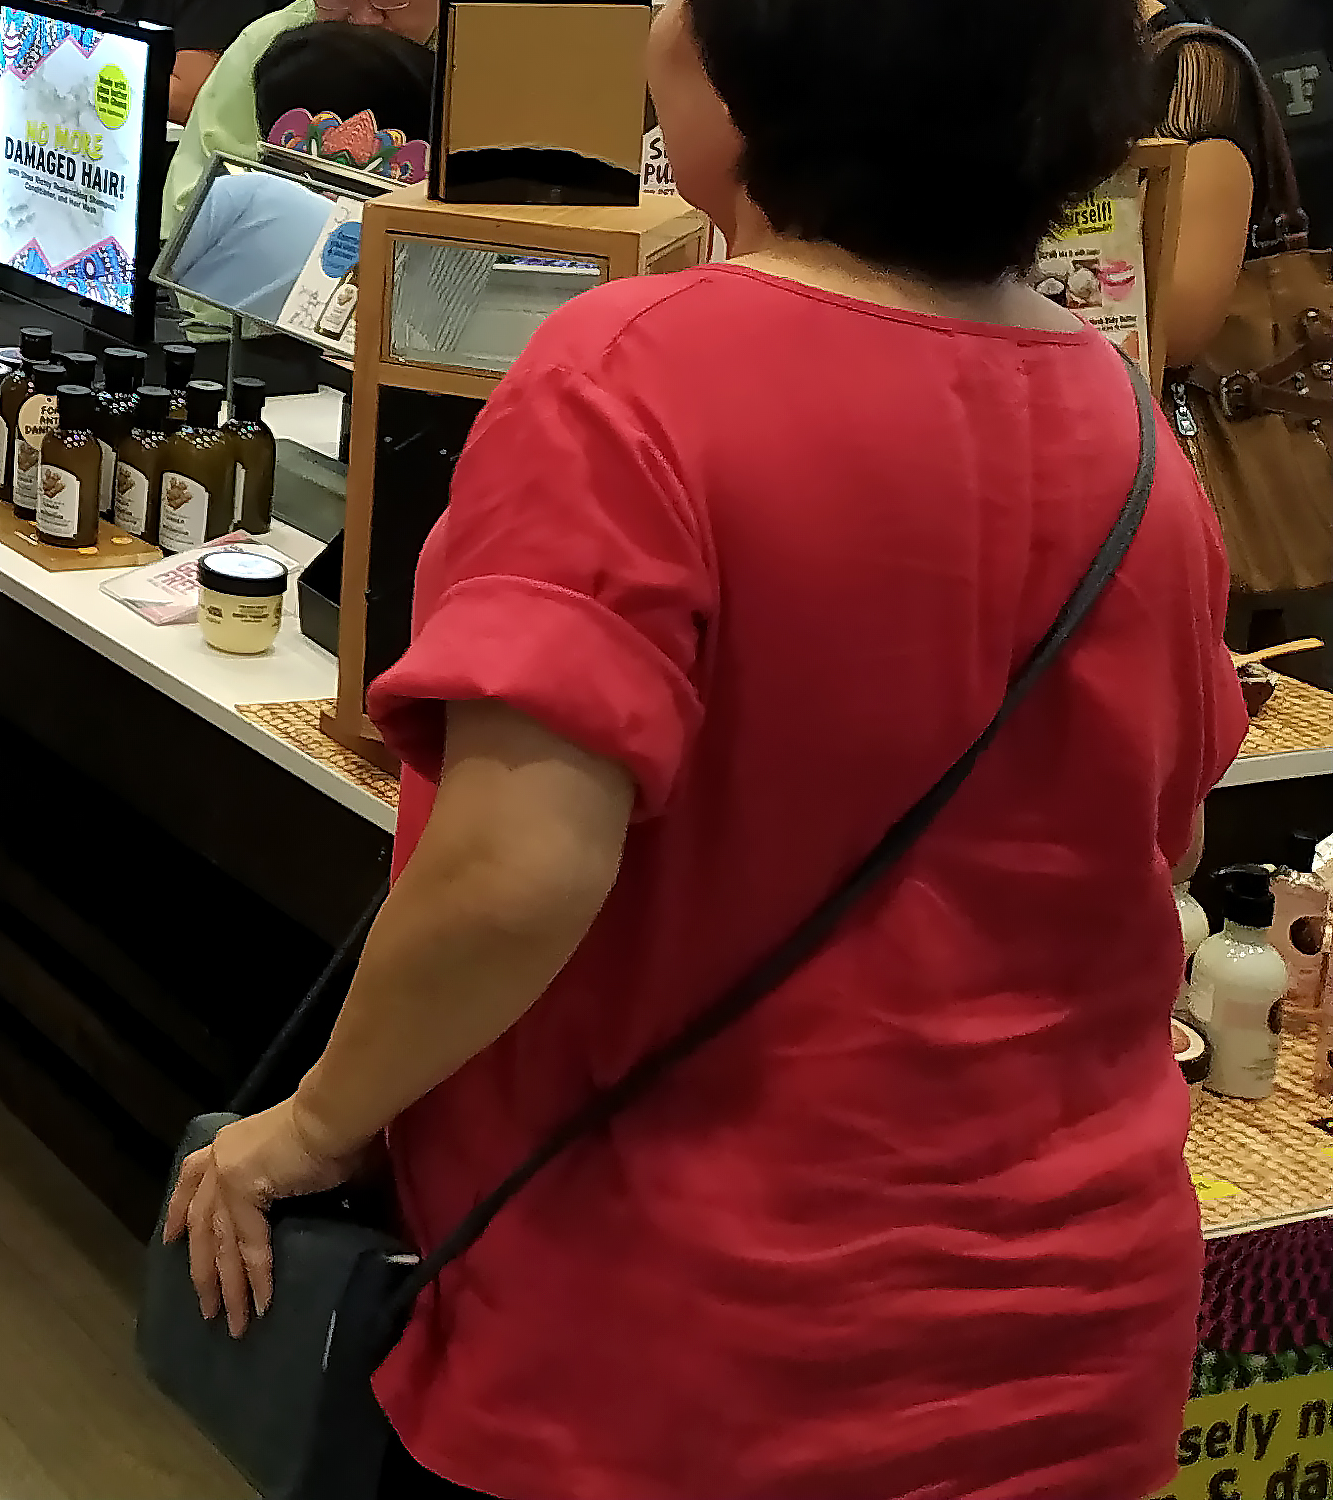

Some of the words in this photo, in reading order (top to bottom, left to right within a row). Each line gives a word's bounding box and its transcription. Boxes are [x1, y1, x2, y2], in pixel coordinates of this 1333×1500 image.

[26, 120, 50, 147] NO
[54, 124, 104, 162] MORE
[4, 136, 77, 181] DAMAGED
[81, 161, 126, 200] HAIR!
[1071, 200, 1113, 226] rself!
[1176, 1402, 1282, 1461] sely
